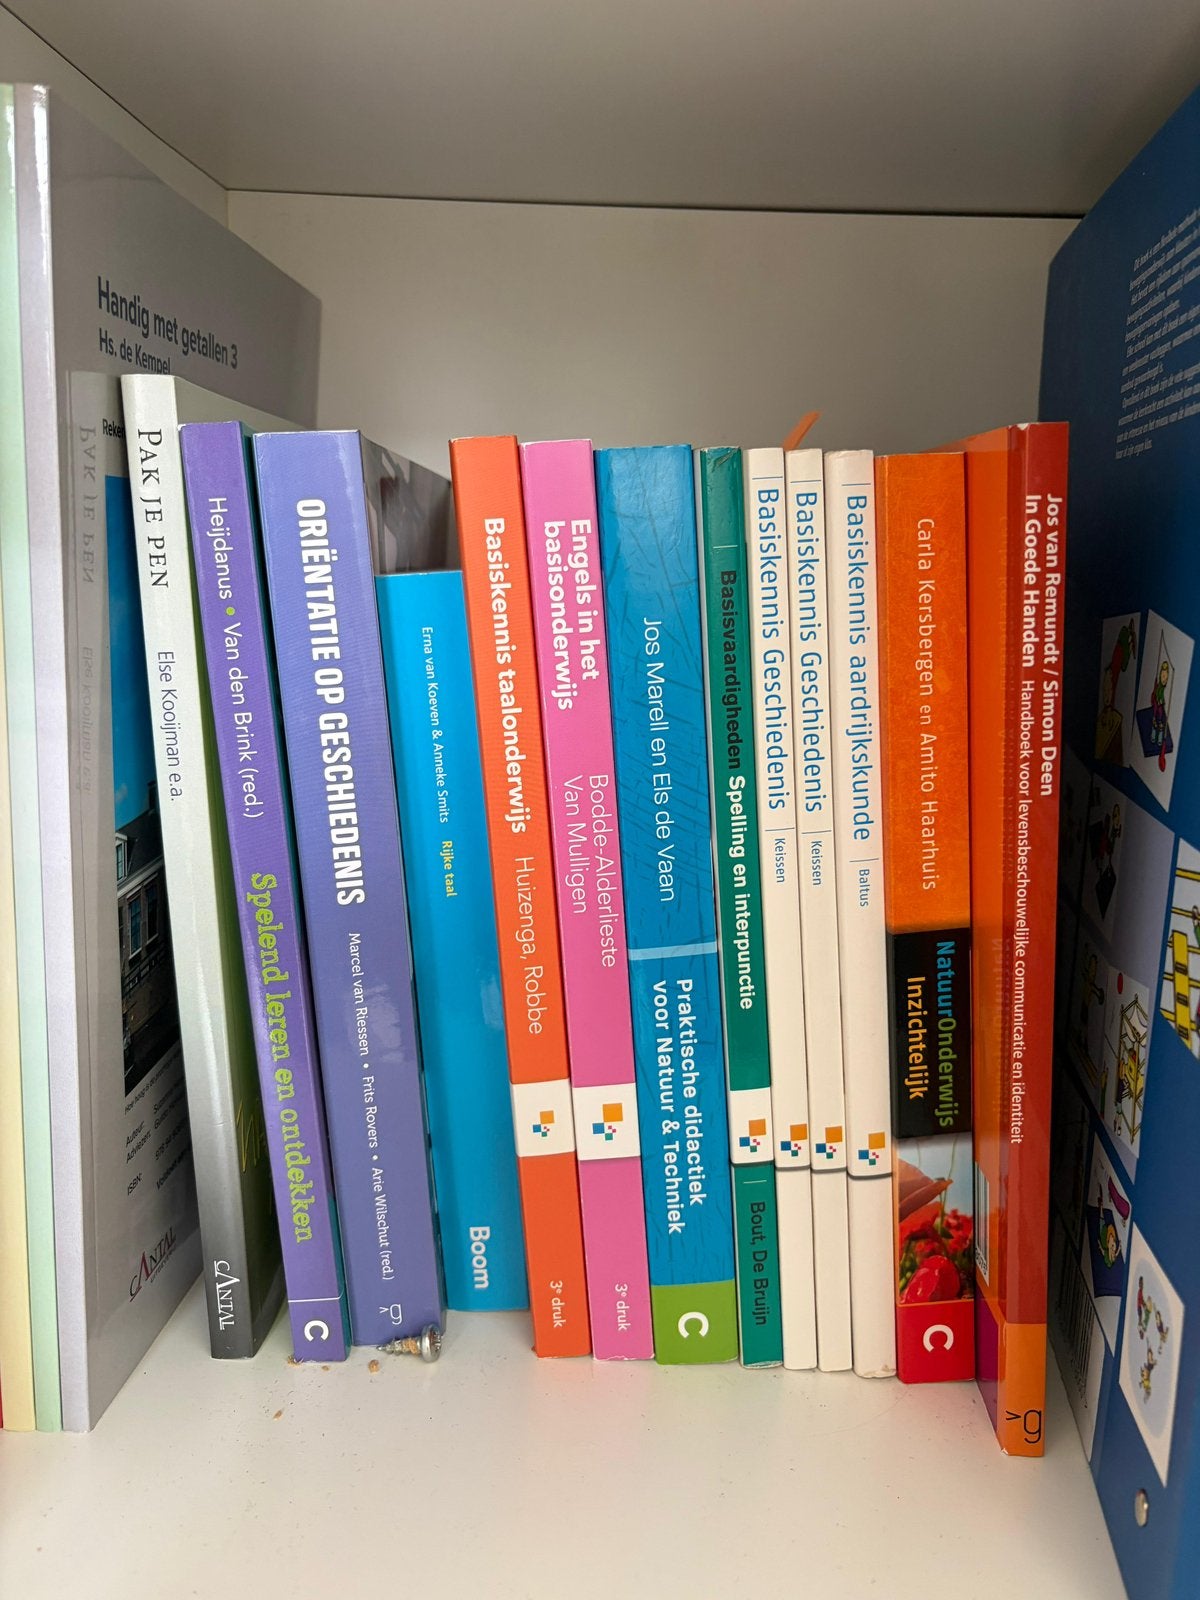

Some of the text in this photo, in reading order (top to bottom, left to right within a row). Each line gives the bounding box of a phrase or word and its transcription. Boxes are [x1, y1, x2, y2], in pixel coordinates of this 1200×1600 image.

[98, 276, 238, 370] Handig met getallen 3
[99, 327, 171, 375] Hs. de Kempel
[138, 428, 169, 588] PAK JE PEN
[206, 497, 233, 600] Heijdanus
[1045, 530, 1059, 568] van
[1046, 493, 1063, 527] Jos
[544, 520, 578, 711] basisonderwijs
[568, 518, 601, 681] Engels in het
[757, 488, 790, 810] Basiskennis Geschiedenis
[795, 492, 827, 813] Basiskennis Geschiedenis
[846, 495, 875, 841] Basiskennis aardrijkskunde
[1043, 573, 1061, 664] Remundt
[158, 651, 183, 801] Else Kooijman e.a.
[224, 622, 264, 818] Van den Brink (red.)
[296, 499, 365, 906] ORIËNTATIE OP GESCHIEDENIS
[422, 627, 450, 823] Erna van Koeven & Anneke Smits
[484, 517, 531, 834] Basiskennis taalonderwijs
[915, 518, 940, 891] Carla Kersbergen en Amito Haarhuis
[1042, 680, 1059, 742] Simon
[643, 617, 675, 902] Jos Marell en Els de Vaan
[720, 570, 756, 1010] Basisvaardigheden Spelling en interpunctie
[1010, 494, 1042, 1144] In Goede Handen Handboek voor levensbeschouwelijke communicatie en identiteit
[1040, 746, 1057, 797] Deen
[440, 840, 457, 897] Rijke taal
[563, 774, 591, 914] Van Mulligen
[589, 774, 619, 968] Bodde-Alderlieste
[774, 838, 786, 883] Keissen
[811, 840, 823, 886] Keissen
[859, 868, 870, 907] Baltus
[348, 932, 370, 1056] Marcel van Riessen
[514, 856, 547, 1035] Huizenga, Robbe
[247, 872, 315, 1243] Spelend leren en ontdekken
[676, 979, 707, 1206] Praktische didactiek
[904, 976, 929, 1100] Inzichtelijk
[934, 941, 959, 1127] NatuurOnderwijs
[361, 1075, 379, 1149] Frits Rovers
[652, 980, 686, 1235] voor Natuur & Techniek
[371, 1166, 395, 1281] Arie Wilschut (red.)
[469, 1226, 491, 1289] Boom
[749, 1202, 769, 1327] Bout, De Bruijn
[551, 1297, 566, 1328] druk
[616, 1300, 631, 1331] druk
